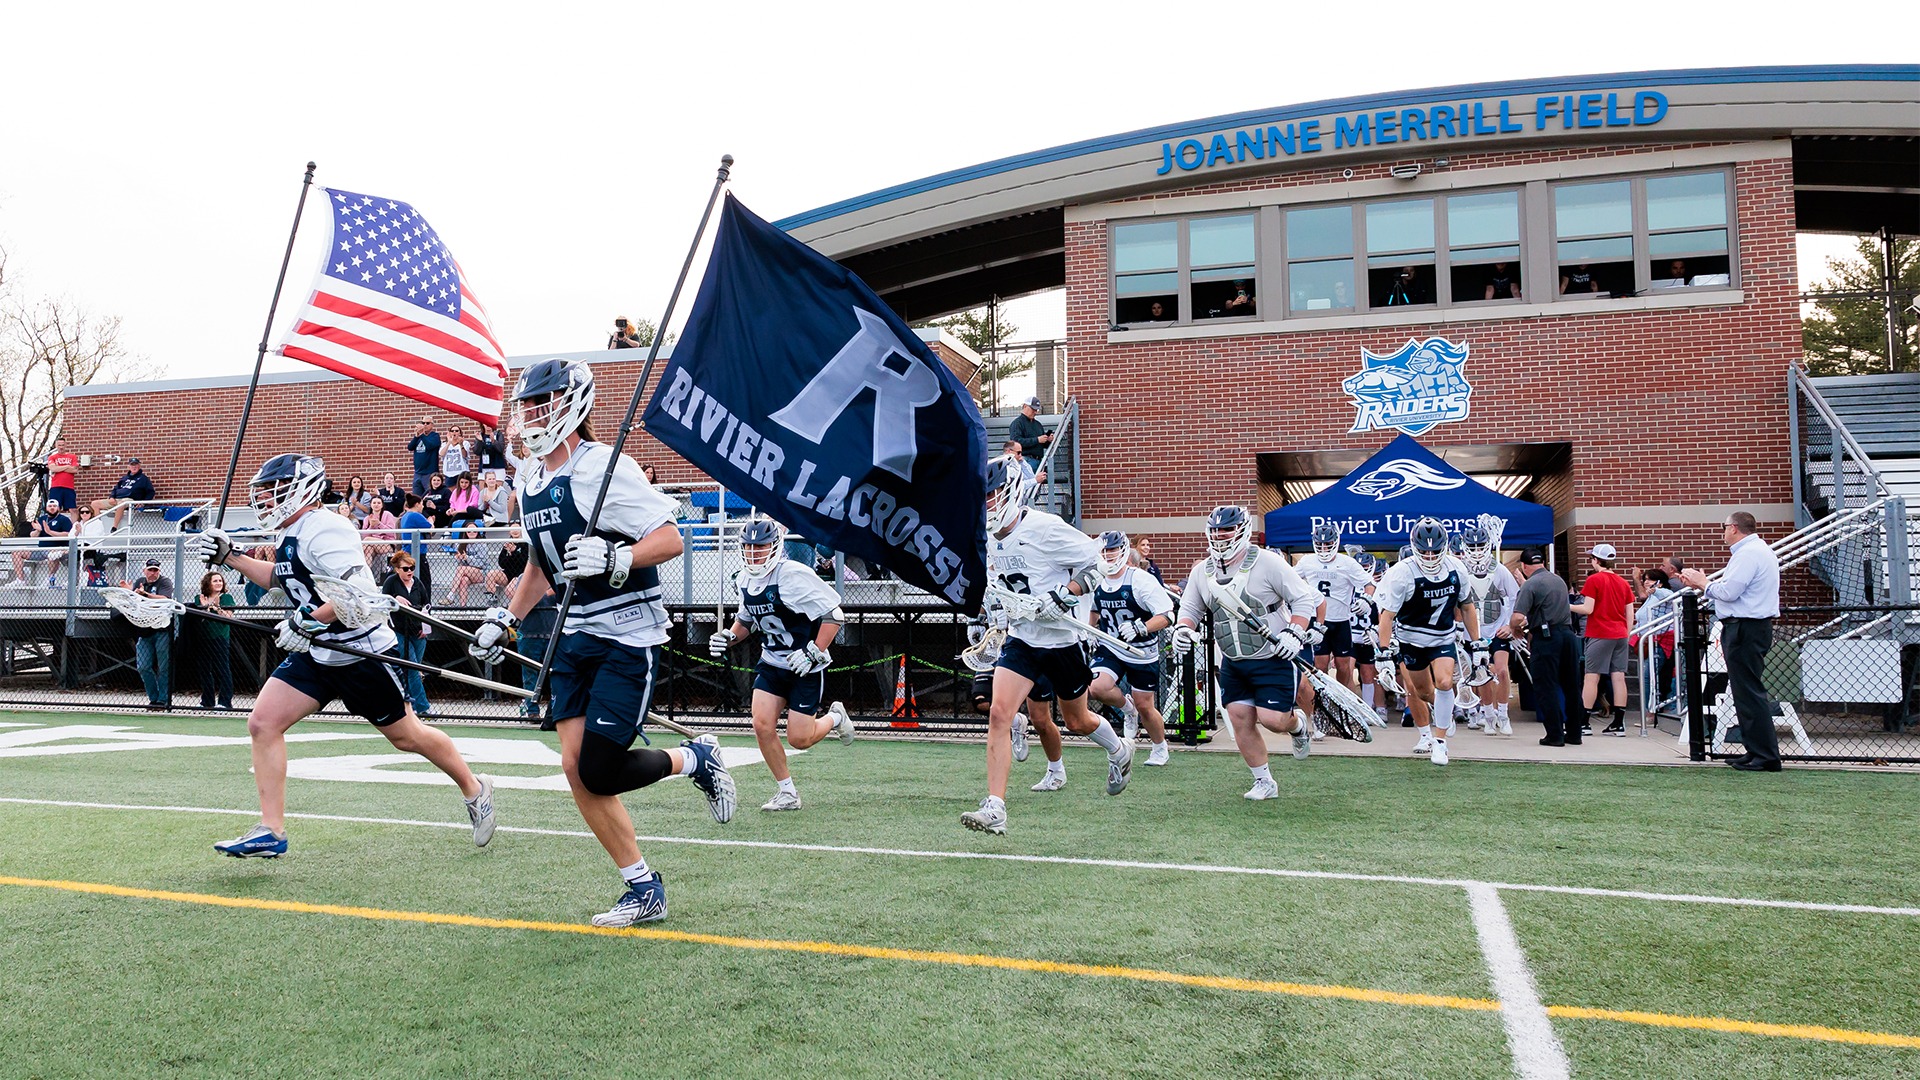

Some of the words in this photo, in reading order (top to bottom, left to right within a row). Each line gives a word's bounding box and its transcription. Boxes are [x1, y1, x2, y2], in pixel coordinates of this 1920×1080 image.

[1156, 119, 1323, 176] JOANNE
[1334, 98, 1524, 149] MERRILL
[1535, 90, 1669, 130] FIELD
[767, 304, 944, 484] R
[1350, 392, 1469, 431] RAIDERS
[660, 365, 787, 492] RIVIER
[786, 459, 972, 605] LACROSSE
[524, 506, 562, 531] RIVIER
[1385, 514, 1508, 539] Unersiy
[1423, 585, 1456, 598] RIVIER
[1428, 596, 1450, 626] 7
